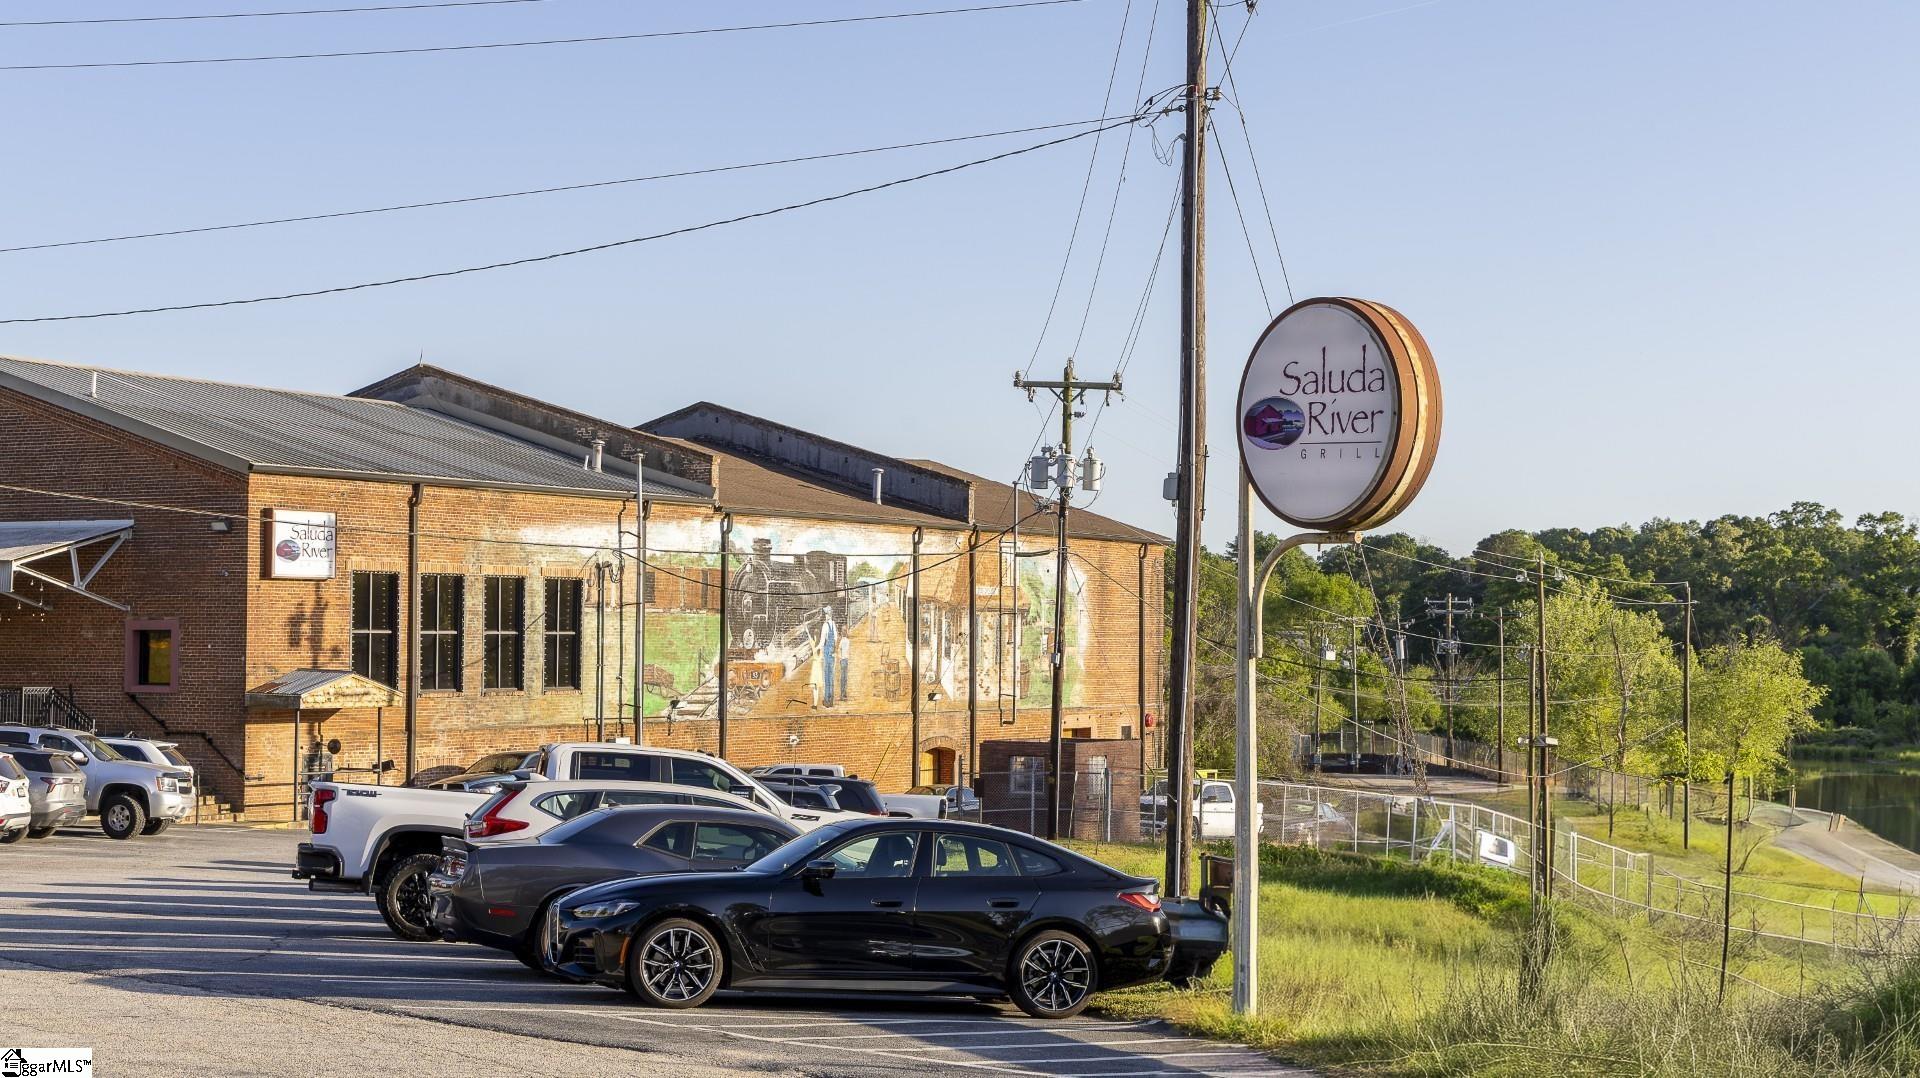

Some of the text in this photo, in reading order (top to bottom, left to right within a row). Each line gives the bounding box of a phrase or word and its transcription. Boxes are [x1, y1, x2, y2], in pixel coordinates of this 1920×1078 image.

[1279, 344, 1385, 396] Saluda
[1308, 399, 1384, 435] River
[1300, 448, 1380, 459] GRILL
[290, 520, 333, 541] Saluda
[302, 542, 333, 558] River
